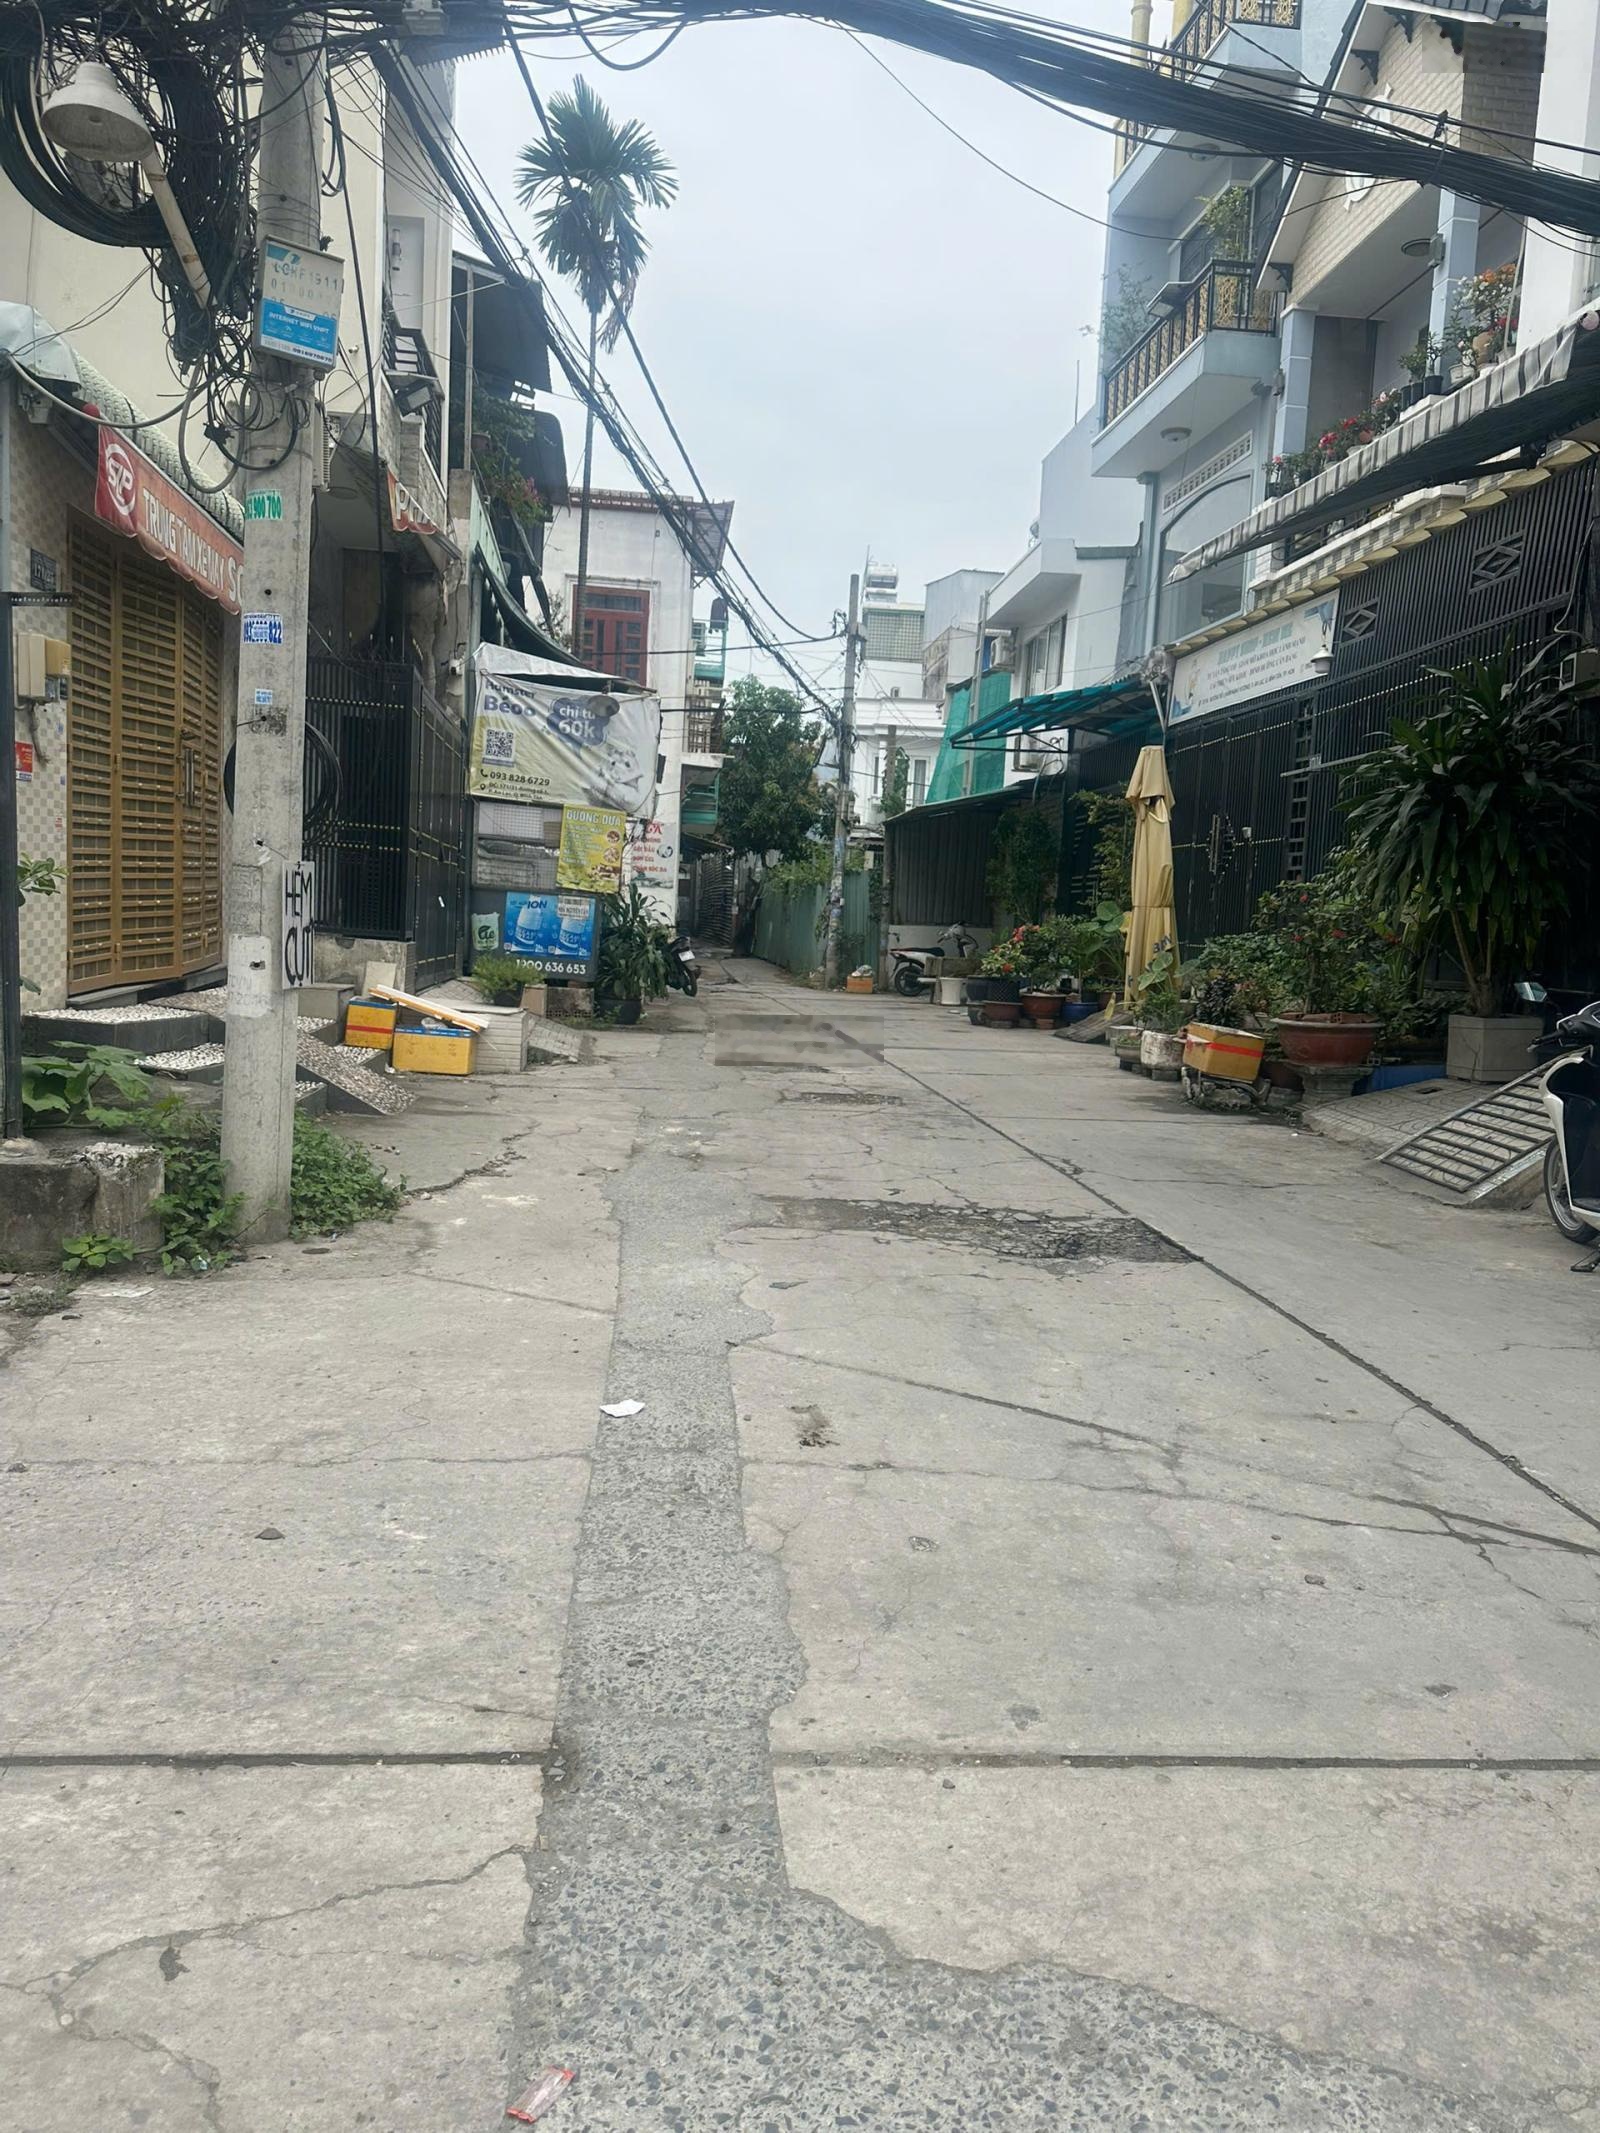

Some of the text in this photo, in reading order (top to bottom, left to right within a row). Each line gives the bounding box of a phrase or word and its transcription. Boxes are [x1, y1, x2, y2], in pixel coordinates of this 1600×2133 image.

[143, 488, 177, 554] TRUNG
[558, 719, 596, 738] 60k
[489, 771, 550, 786] 093 828 6729
[528, 900, 548, 909] ION
[545, 961, 564, 973] 636
[566, 963, 587, 975] 653
